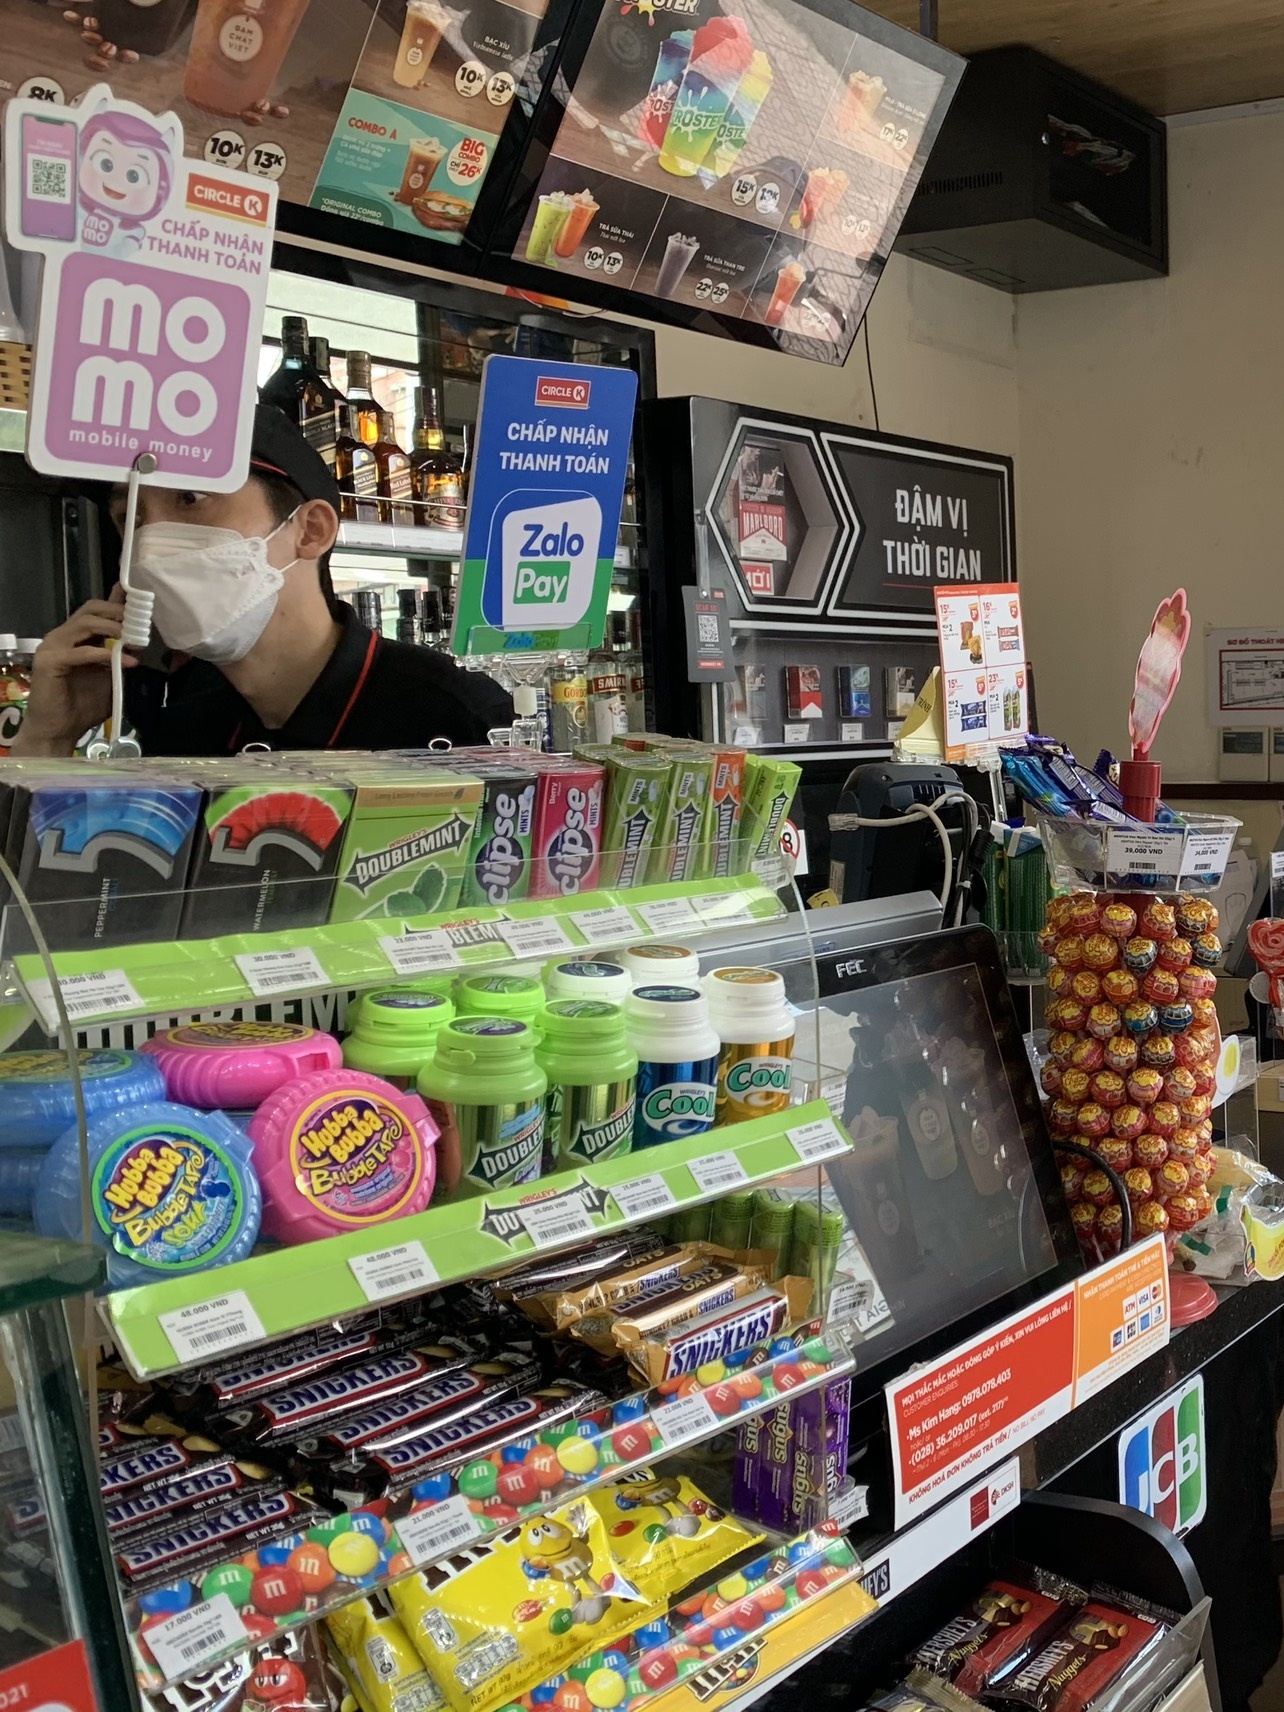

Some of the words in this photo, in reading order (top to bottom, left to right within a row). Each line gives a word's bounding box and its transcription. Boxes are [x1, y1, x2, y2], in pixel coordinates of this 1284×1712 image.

[348, 117, 387, 136] COMBO
[210, 138, 243, 157] 10K
[254, 149, 285, 169] 13K
[458, 152, 480, 164] COMBO
[461, 137, 485, 156] BIG
[194, 185, 241, 207] CIRCLE
[357, 206, 382, 218] COMBO
[161, 219, 209, 241] CHẤP
[214, 231, 263, 256] NHẬN
[147, 235, 209, 263] THANH
[216, 252, 261, 275] TOÁN
[79, 278, 226, 363] mo
[71, 356, 218, 436] mo
[541, 384, 572, 399] CIRCLE
[573, 386, 585, 401] K
[69, 427, 140, 450] mobile
[148, 437, 213, 462] money
[507, 420, 557, 444] CHẤP
[560, 423, 609, 447] NHẬN
[500, 452, 561, 472] THANH
[564, 452, 609, 475] TOÁN
[895, 484, 942, 532] ĐẬM
[946, 498, 968, 537] VỊ
[520, 522, 585, 557] Zalo
[743, 512, 783, 541] MARLBORO
[883, 536, 930, 577] THỜI
[936, 547, 981, 581] GIAN
[516, 568, 567, 603] Pay
[680, 774, 692, 795] MINTS
[717, 765, 727, 787] MINTS
[630, 781, 644, 803] MINTS
[519, 809, 529, 833] MINTS
[589, 803, 598, 825] MINTS
[356, 821, 461, 884] DOUBLEMINT
[94, 877, 111, 938] PEPPERMINT
[253, 869, 271, 931] WATERMELON
[835, 959, 868, 978] FEC
[301, 1105, 357, 1157] Hubba
[329, 1110, 384, 1163] Bubba
[105, 1148, 155, 1209] Hubba
[136, 1147, 184, 1207] Bubba
[310, 1157, 377, 1194] Bubble
[518, 1187, 557, 1204] WRIGLEY'S
[533, 1205, 553, 1216] 25.000
[554, 1200, 567, 1209] VND
[125, 1194, 188, 1246] Bubble
[366, 1252, 390, 1263] 48.000
[391, 1248, 407, 1258] VND
[639, 1267, 679, 1290] SNICKERS
[682, 1272, 722, 1292] OATS
[181, 1304, 209, 1318] 48.000
[211, 1299, 229, 1310] VND
[699, 1288, 735, 1314] SNICKERS
[1124, 1300, 1136, 1315] ATM
[1138, 1292, 1149, 1306] VISA
[671, 1309, 771, 1377] SNICKERS
[915, 1383, 932, 1401] THẮC
[933, 1374, 947, 1389] MẮC
[948, 1363, 964, 1381] HOẶC
[965, 1353, 982, 1369] ĐÓNG
[982, 1345, 995, 1360] GÓP
[1035, 1314, 1049, 1328] LÒNG
[275, 1353, 418, 1415] SNICKERS
[340, 1372, 476, 1441] SNICKERS
[664, 1404, 683, 1415] 22.000
[683, 1398, 694, 1407] VND
[903, 1395, 932, 1418] CUSTOMER
[922, 1414, 938, 1431] Kim
[939, 1404, 961, 1423] Hang:
[962, 1368, 1011, 1407] 0978.078.403
[391, 1400, 532, 1465] SNICKERS
[936, 1413, 977, 1450] 36.209.017
[909, 1483, 931, 1504] KHÔNG
[932, 1473, 945, 1488] HOÁ
[947, 1464, 960, 1481] ĐƠN
[961, 1448, 981, 1470] KHÔNG
[982, 1440, 993, 1457] TRẢ
[995, 1432, 1006, 1449] TIỀN
[1130, 1433, 1198, 1513] JCB
[1001, 1480, 1014, 1495] DKSH
[412, 1511, 434, 1523] 21.000
[436, 1503, 450, 1515] VND
[133, 1496, 285, 1564] SNICKERS
[165, 1612, 192, 1632] 17.000
[193, 1603, 211, 1617] VND
[947, 1631, 988, 1666] Nuggets
[1047, 1654, 1087, 1690] Nuggets
